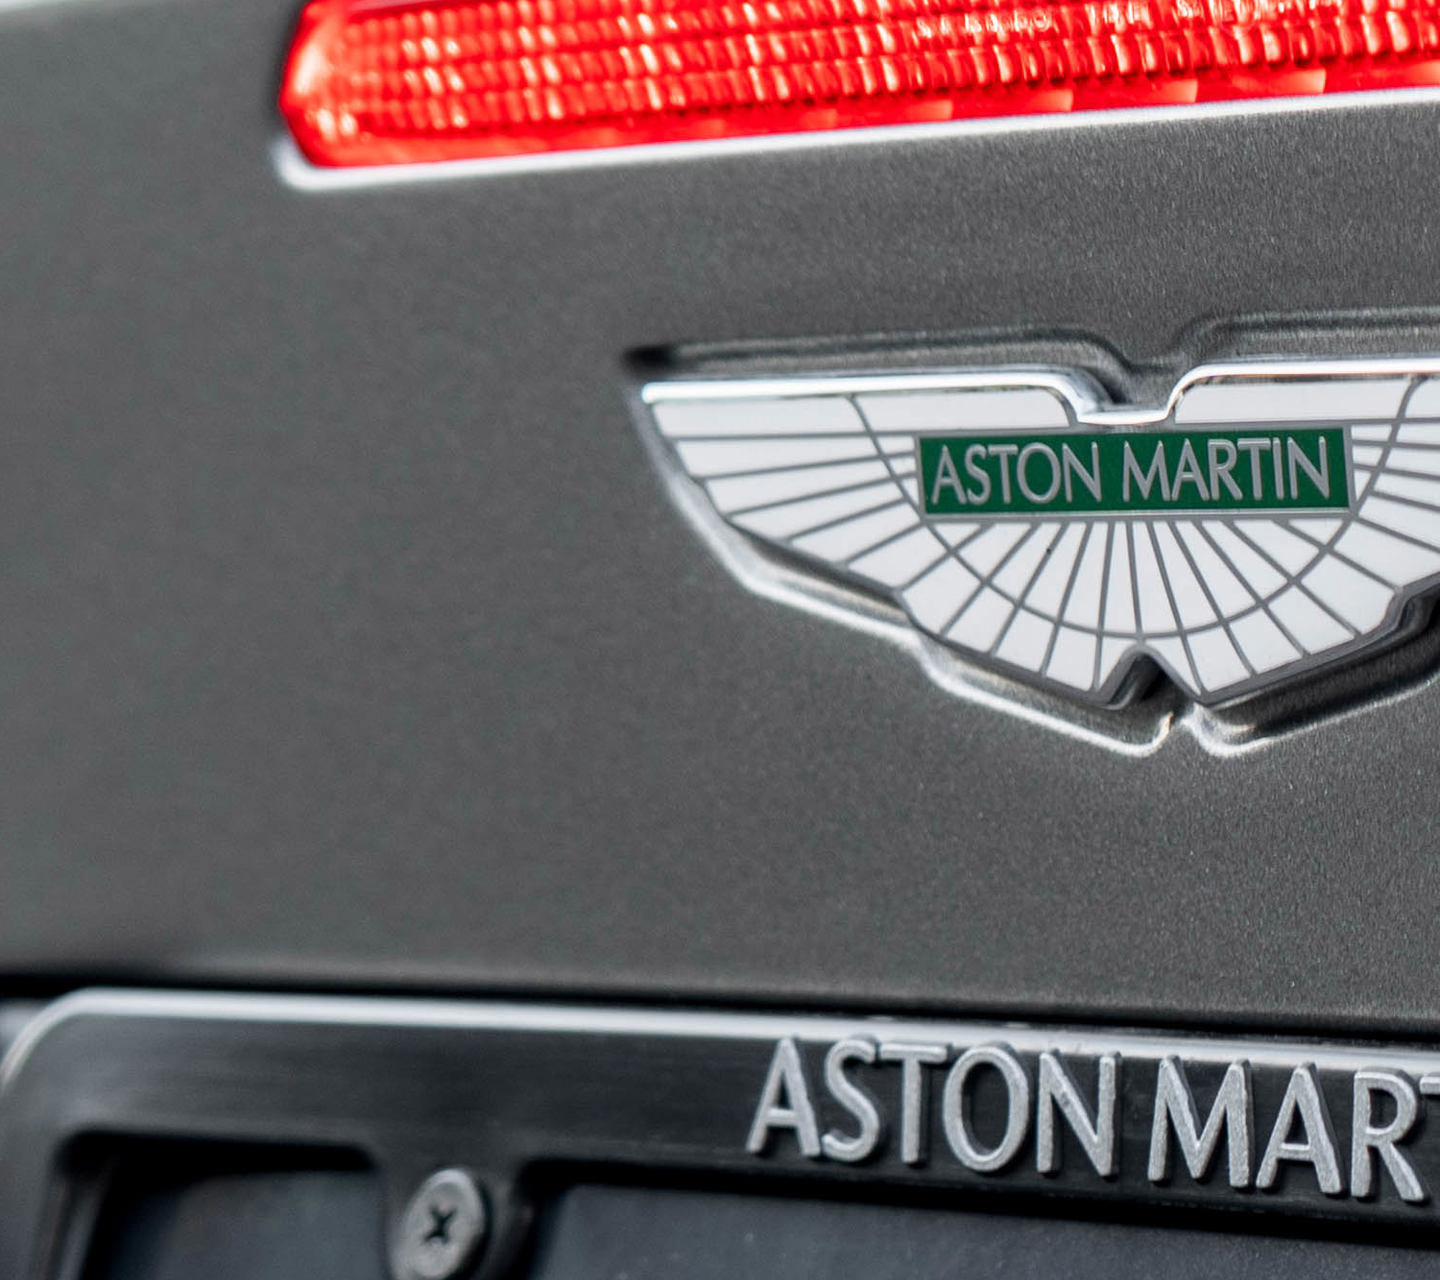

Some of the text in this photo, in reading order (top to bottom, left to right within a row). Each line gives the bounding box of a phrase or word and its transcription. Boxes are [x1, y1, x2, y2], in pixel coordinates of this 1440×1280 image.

[931, 435, 1331, 506] ASTON MARTIN
[746, 1036, 1121, 1179] ASTON
